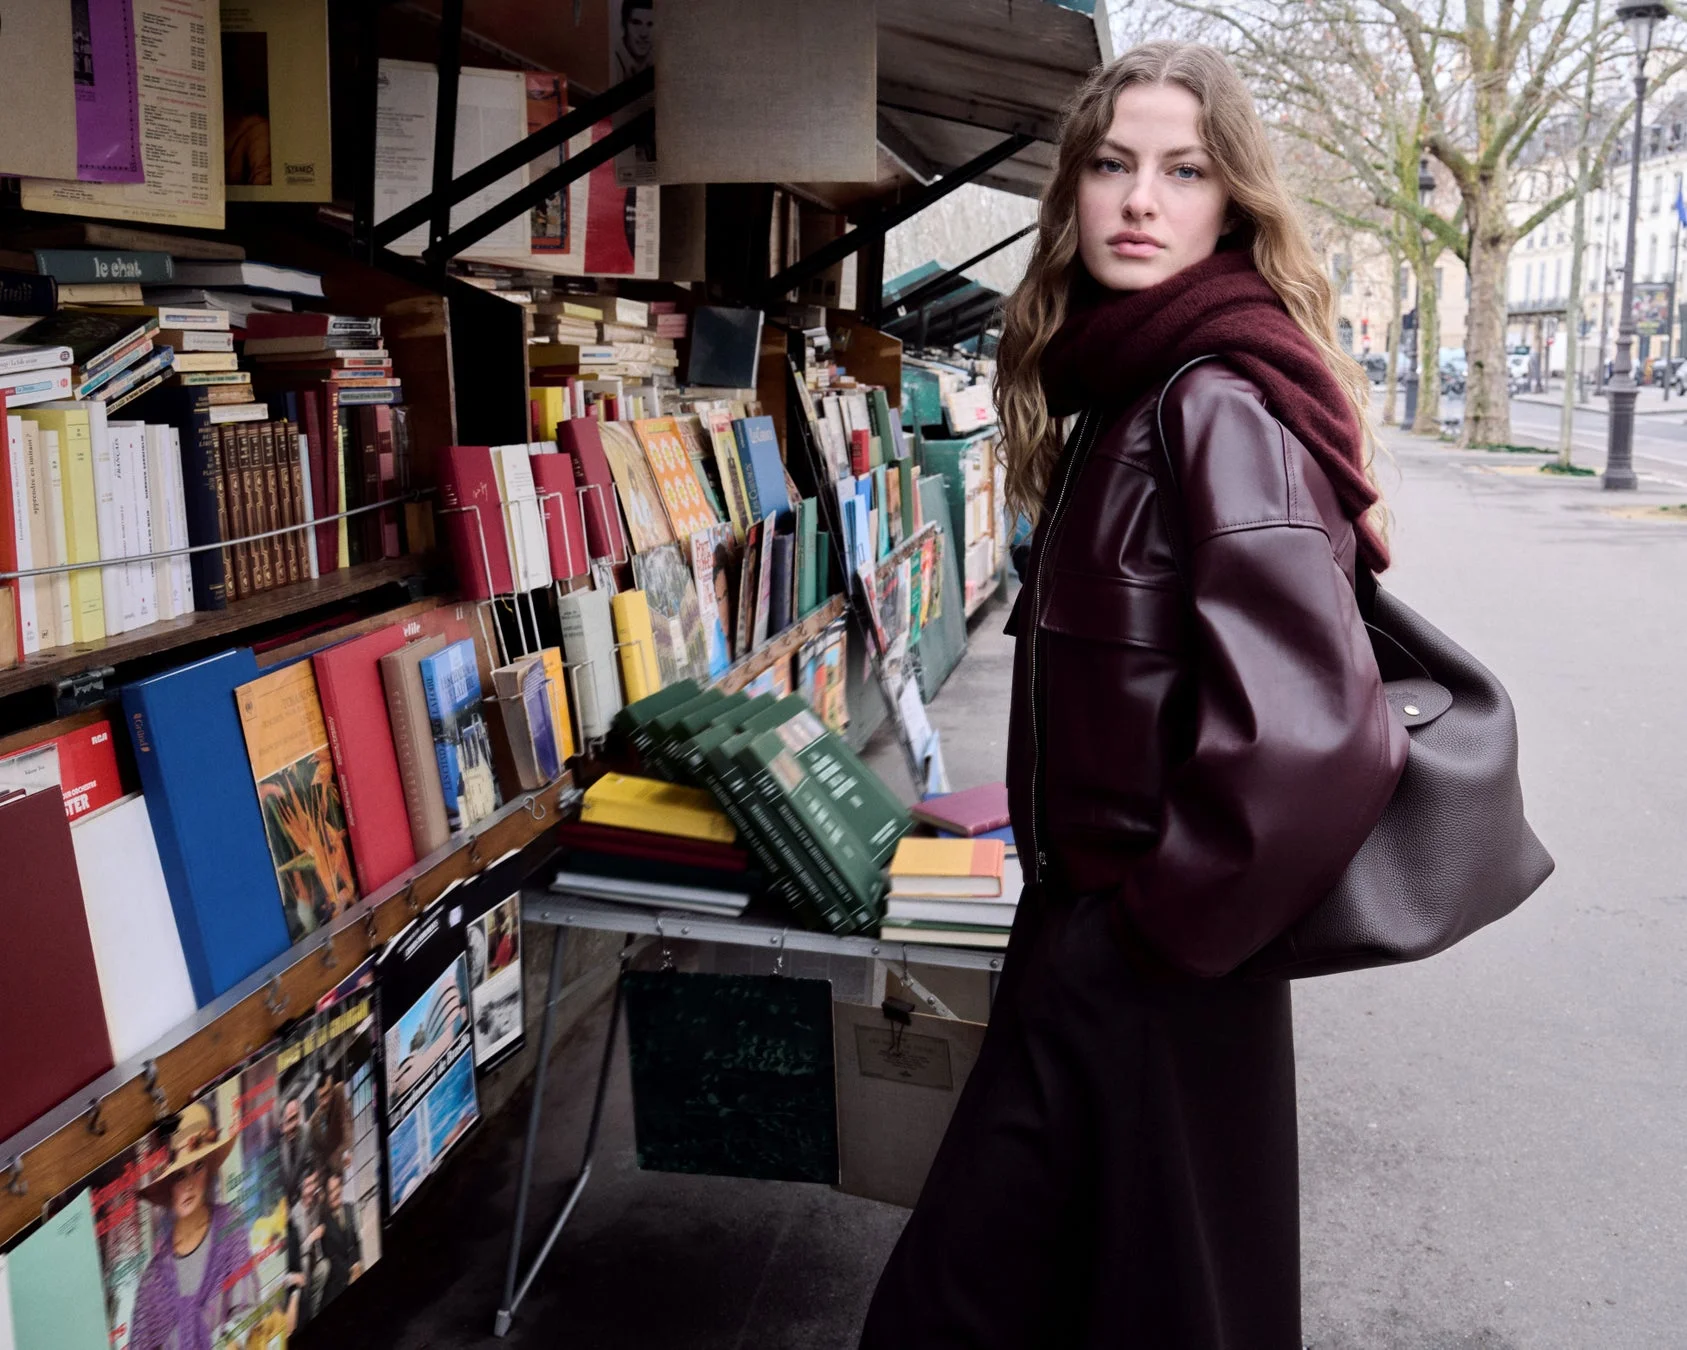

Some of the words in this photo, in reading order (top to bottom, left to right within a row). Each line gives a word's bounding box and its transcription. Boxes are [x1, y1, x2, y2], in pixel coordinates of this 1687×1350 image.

[93, 257, 108, 278] le
[110, 257, 142, 278] chat
[30, 467, 36, 477] en
[30, 480, 40, 515] apprendre
[91, 732, 108, 746] RCA
